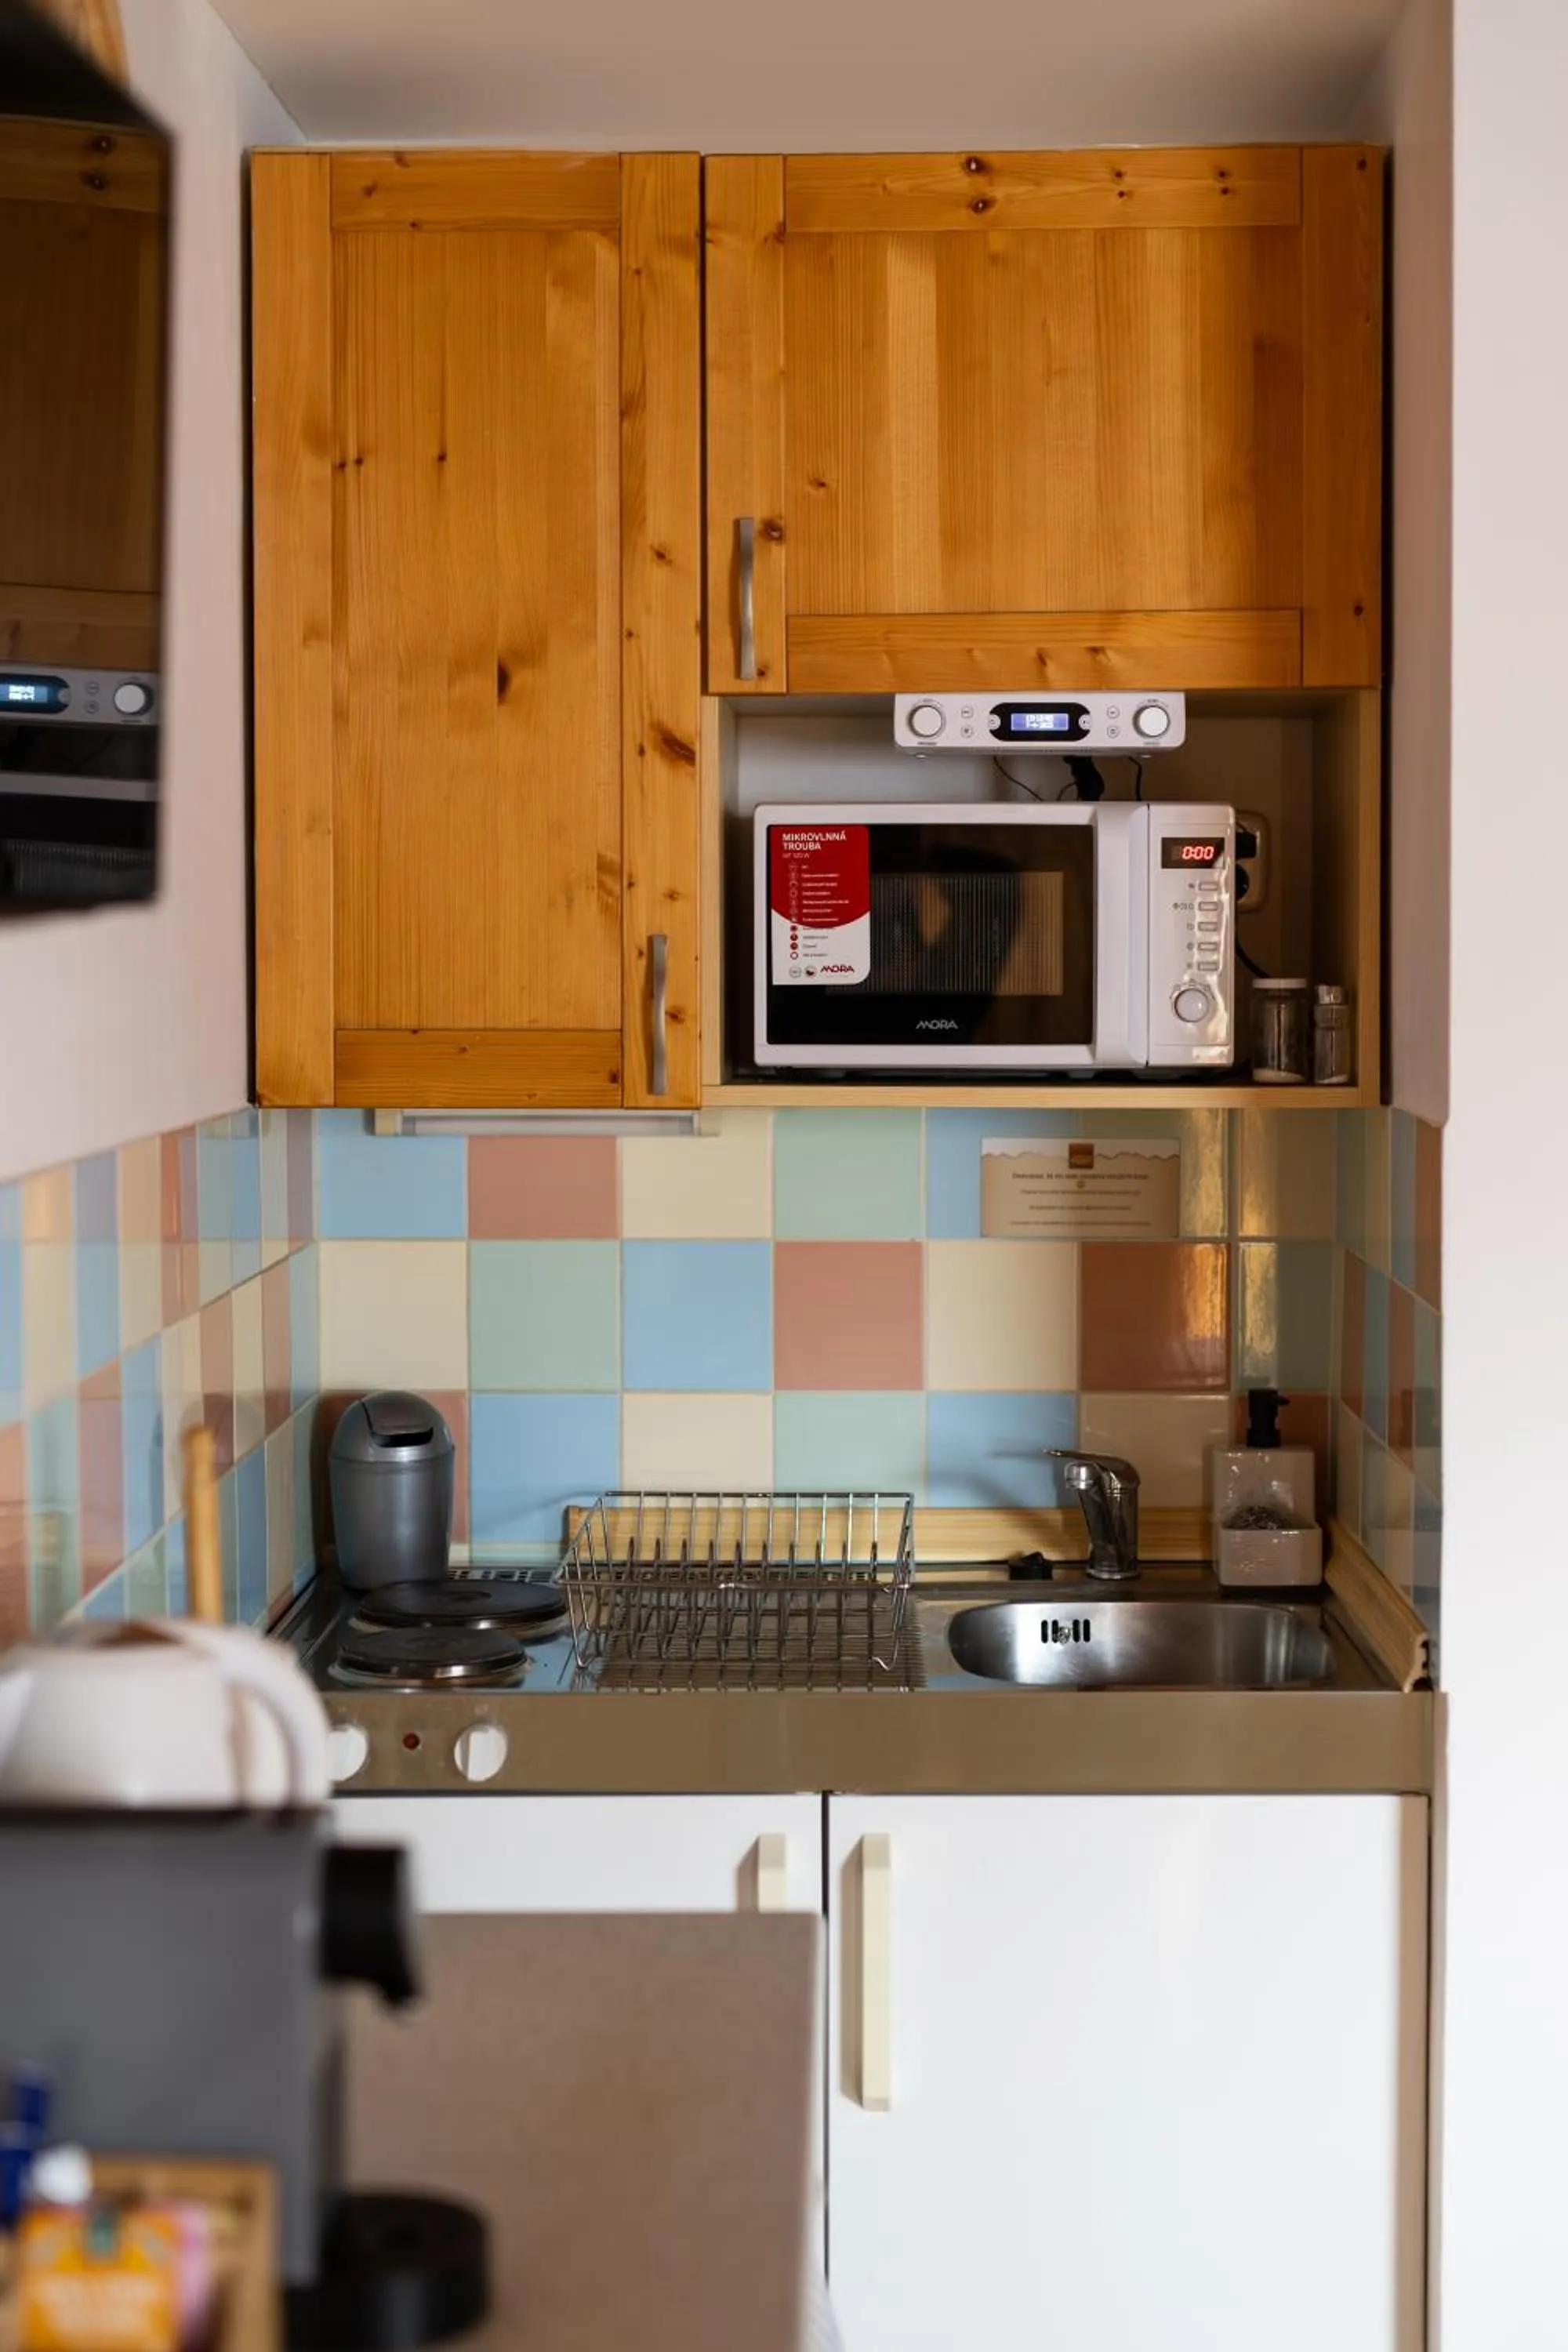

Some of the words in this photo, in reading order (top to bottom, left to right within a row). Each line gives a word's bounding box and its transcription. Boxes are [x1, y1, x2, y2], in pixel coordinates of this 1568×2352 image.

[782, 830, 847, 841] MIKROVLNNÁ
[783, 842, 821, 851] TROUBA
[1182, 846, 1214, 860] 0:00
[820, 964, 855, 973] MORA
[916, 1019, 959, 1029] MORA
